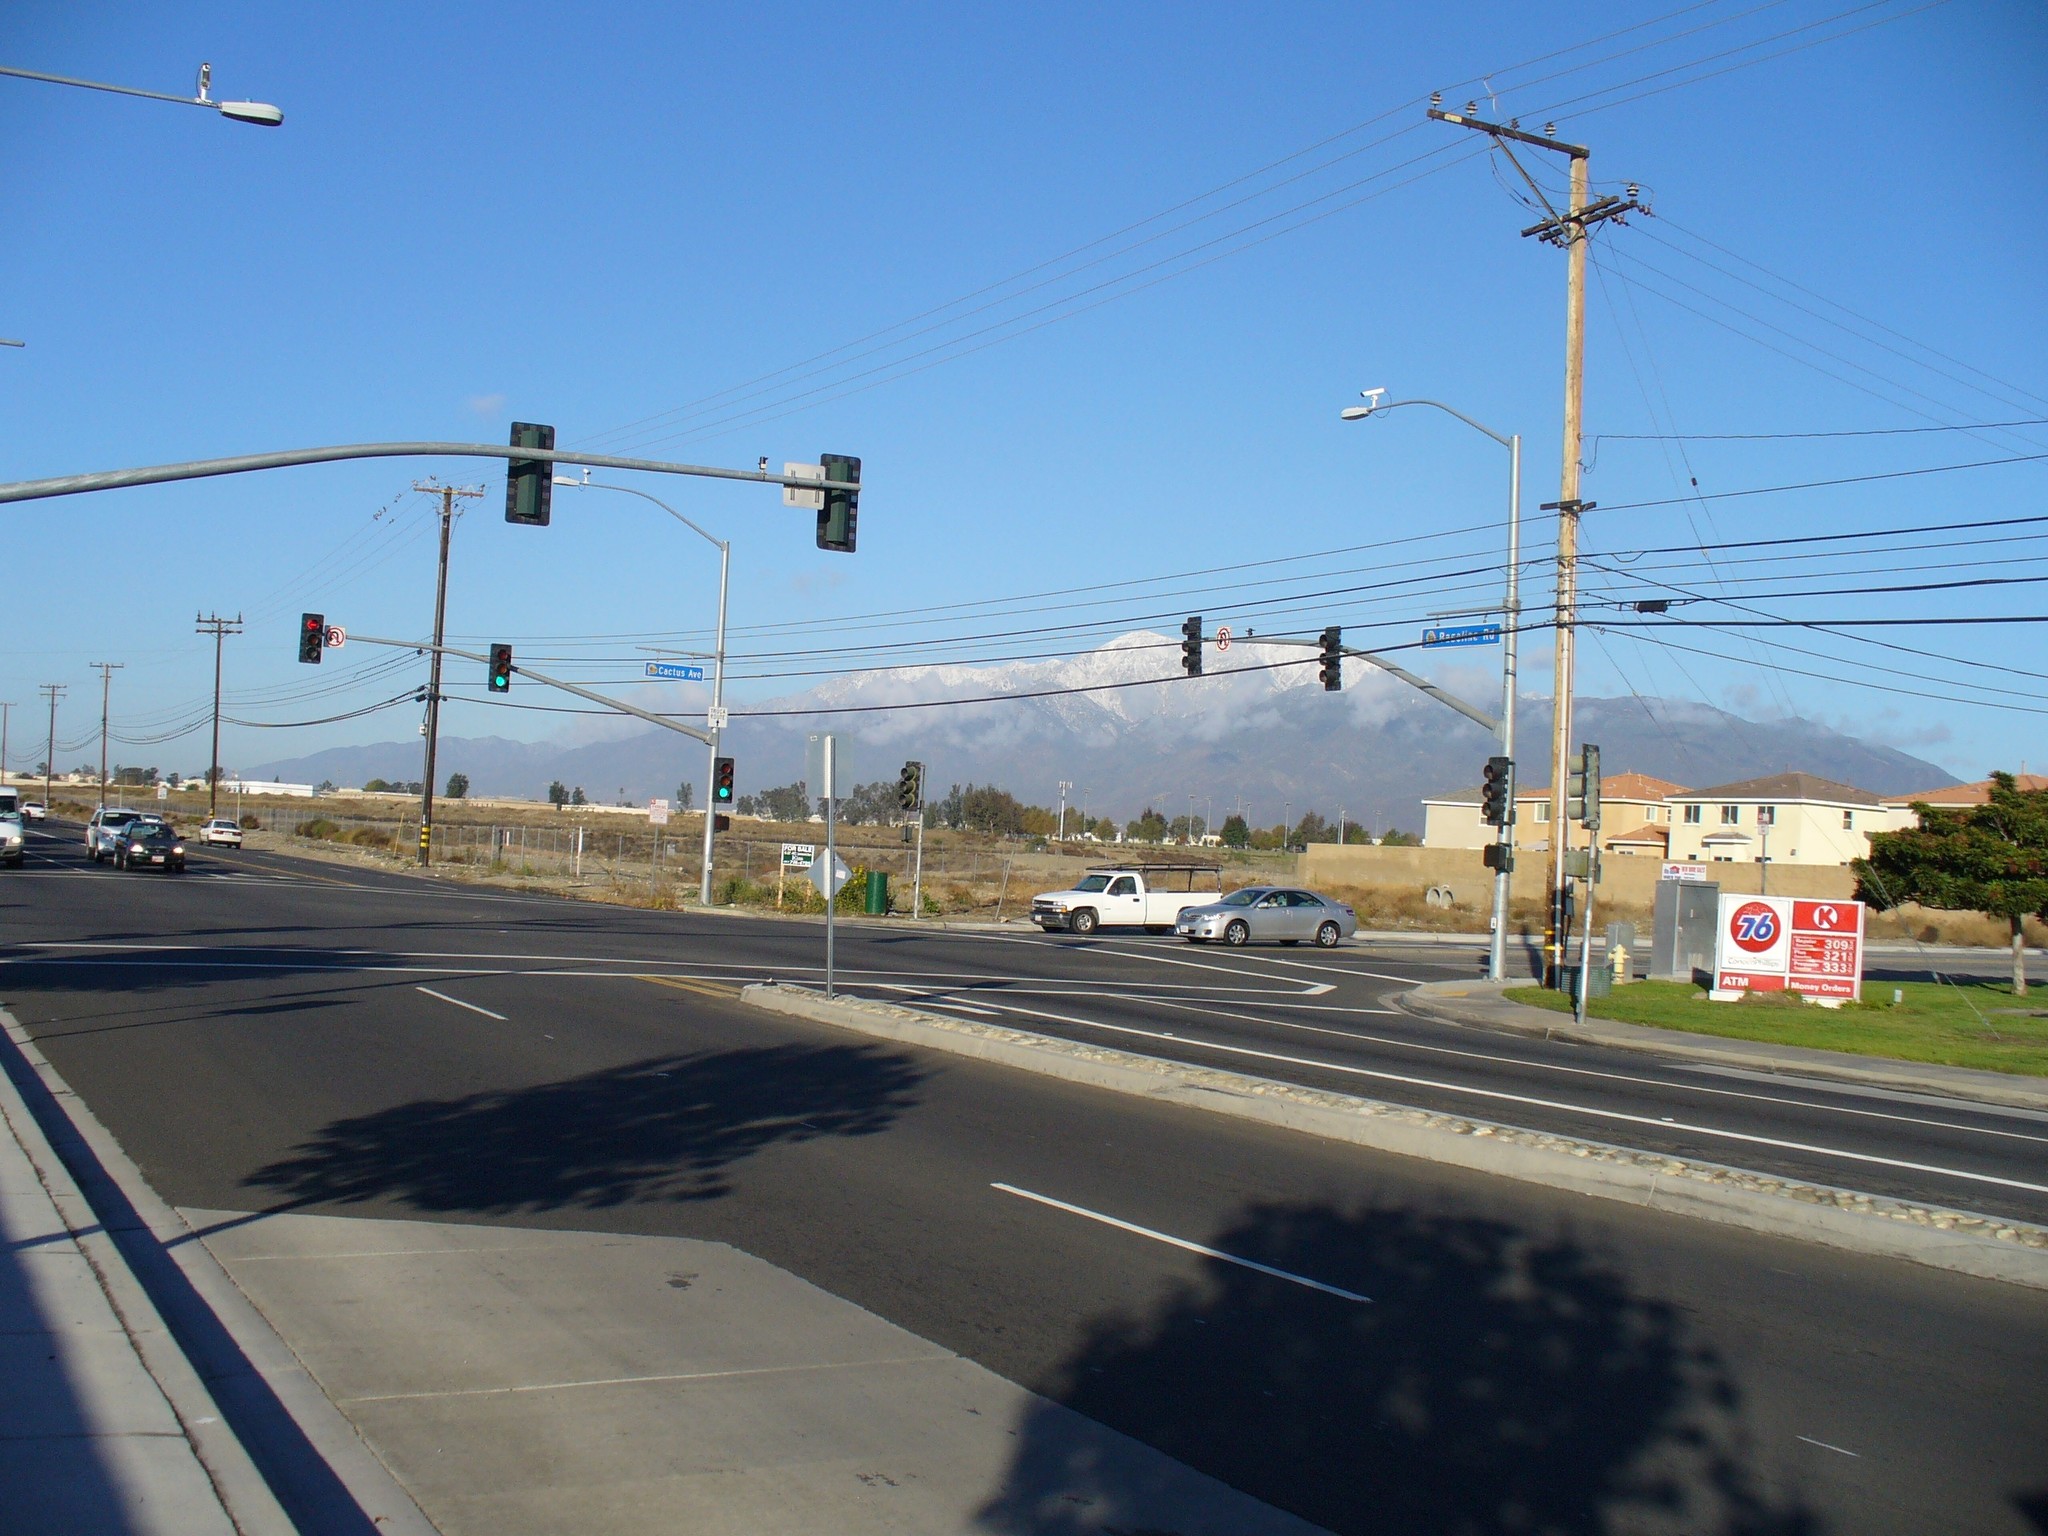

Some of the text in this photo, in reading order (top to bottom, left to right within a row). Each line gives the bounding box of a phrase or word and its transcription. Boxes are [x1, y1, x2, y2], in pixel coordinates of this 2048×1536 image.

[658, 667, 702, 679] Cactus Ave
[1818, 907, 1834, 927] K
[1737, 912, 1773, 941] 76
[1824, 939, 1849, 951] 309
[1822, 950, 1847, 962] 321
[1822, 961, 1847, 973] 333
[1722, 976, 1749, 987] ATM
[1791, 981, 1851, 993] Money Orders
